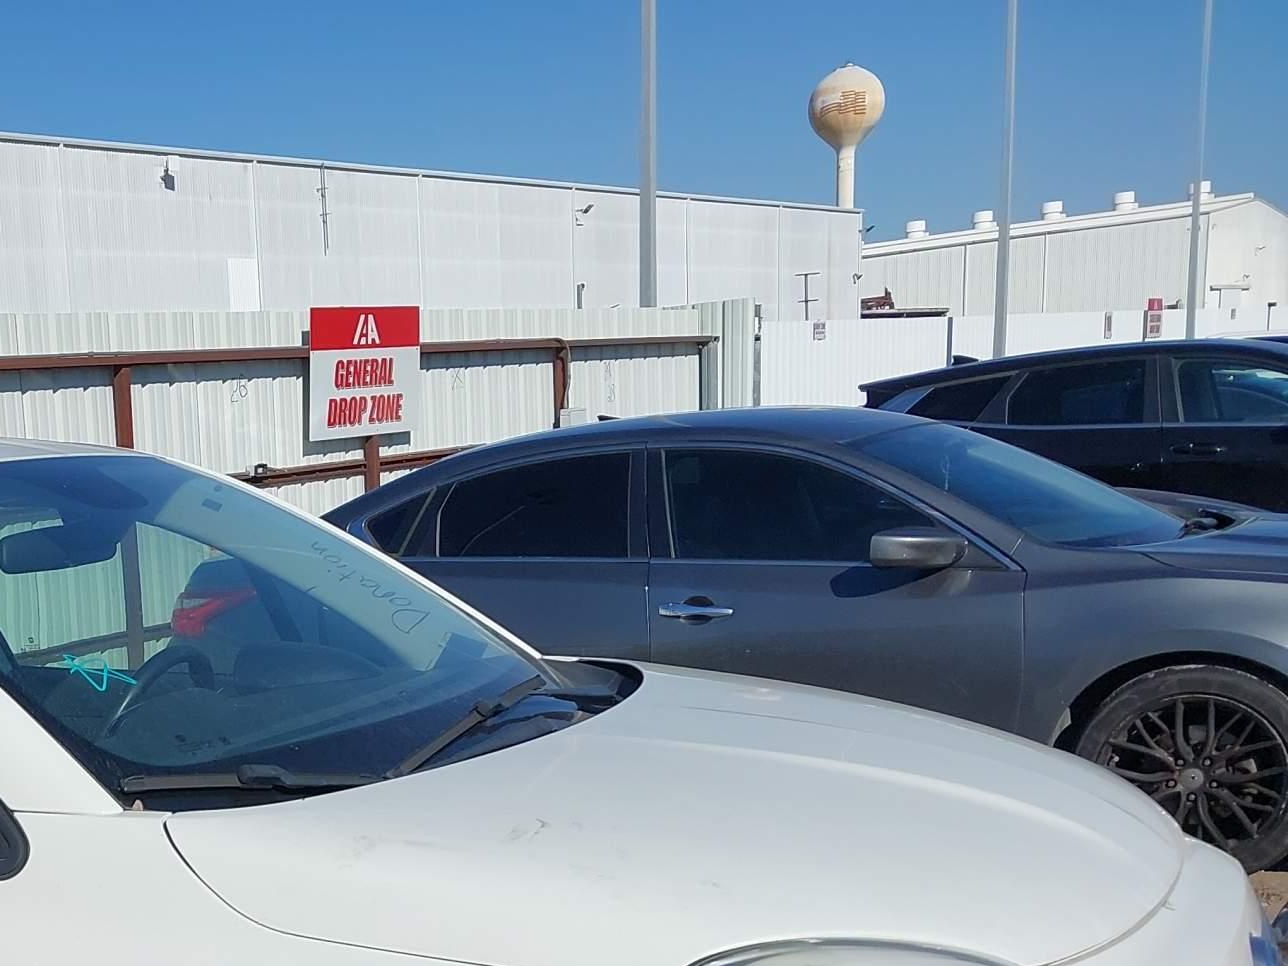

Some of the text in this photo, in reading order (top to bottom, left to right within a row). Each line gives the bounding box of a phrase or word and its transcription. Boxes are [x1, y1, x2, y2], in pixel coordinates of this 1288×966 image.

[334, 357, 395, 390] GENERAL
[327, 393, 404, 428] DROP ZONE
